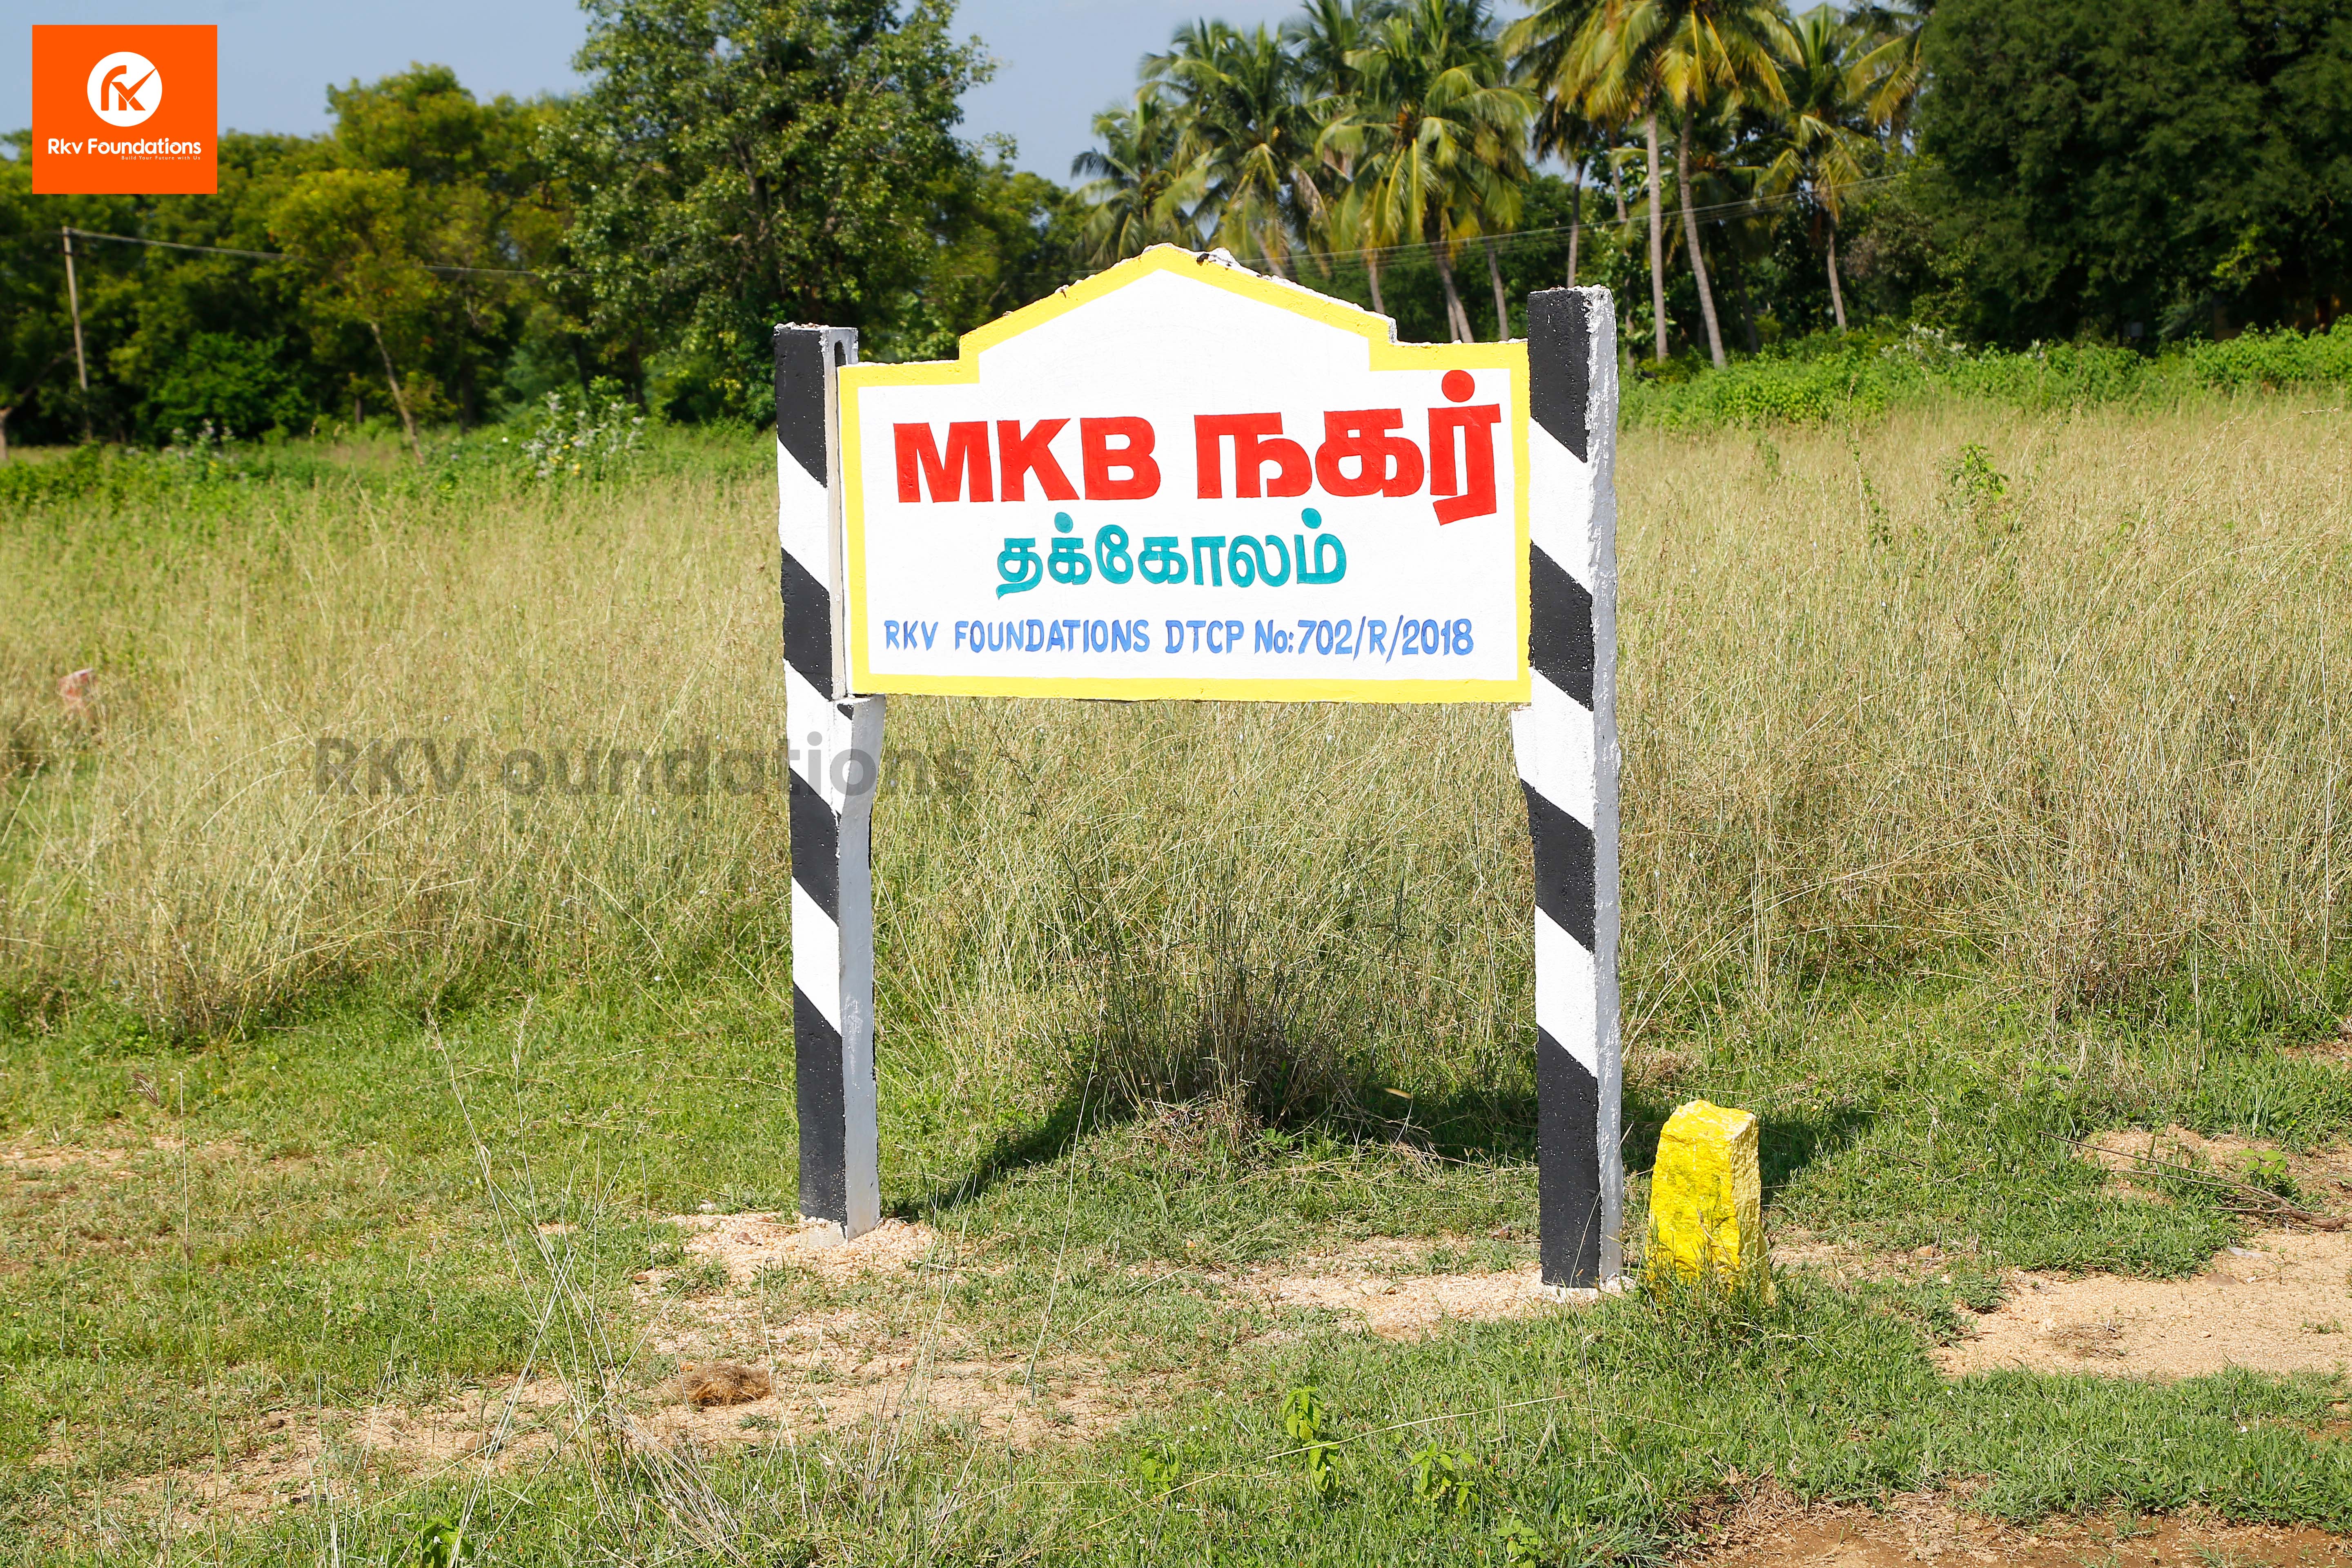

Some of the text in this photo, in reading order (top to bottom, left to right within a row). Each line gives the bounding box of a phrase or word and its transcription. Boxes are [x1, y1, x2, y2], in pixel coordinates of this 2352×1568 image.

[893, 370, 1501, 526] MKB நகர்
[996, 508, 1347, 599] தக்கோலம்
[884, 620, 939, 650] RKV
[955, 619, 1150, 653] FOUNDATIONS
[1165, 620, 1244, 654] DTCP
